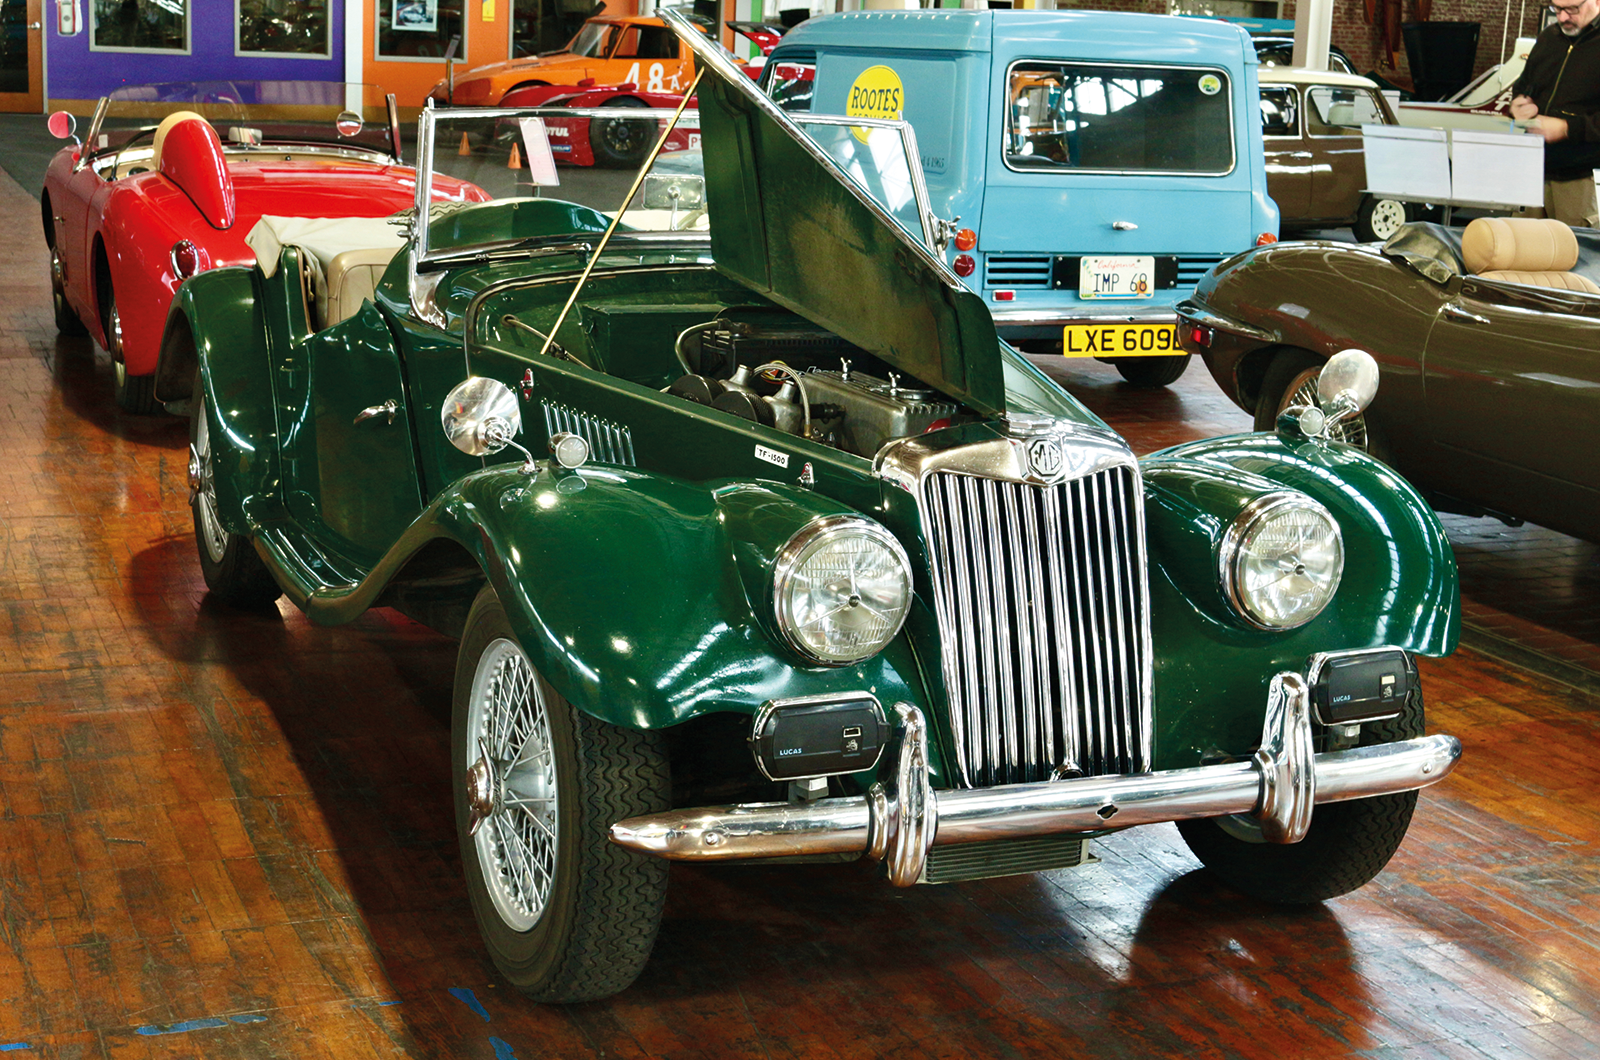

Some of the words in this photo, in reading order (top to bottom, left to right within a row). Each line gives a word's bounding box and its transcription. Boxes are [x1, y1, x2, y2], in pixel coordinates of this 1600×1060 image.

[851, 86, 900, 112] ROOTES
[1097, 259, 1140, 271] California
[1093, 273, 1120, 293] IMP
[1129, 272, 1148, 292] 68
[1068, 329, 1116, 353] LXE
[1033, 443, 1061, 472] MG
[1333, 694, 1351, 703] LUCAS
[779, 747, 802, 756] LUCAS
